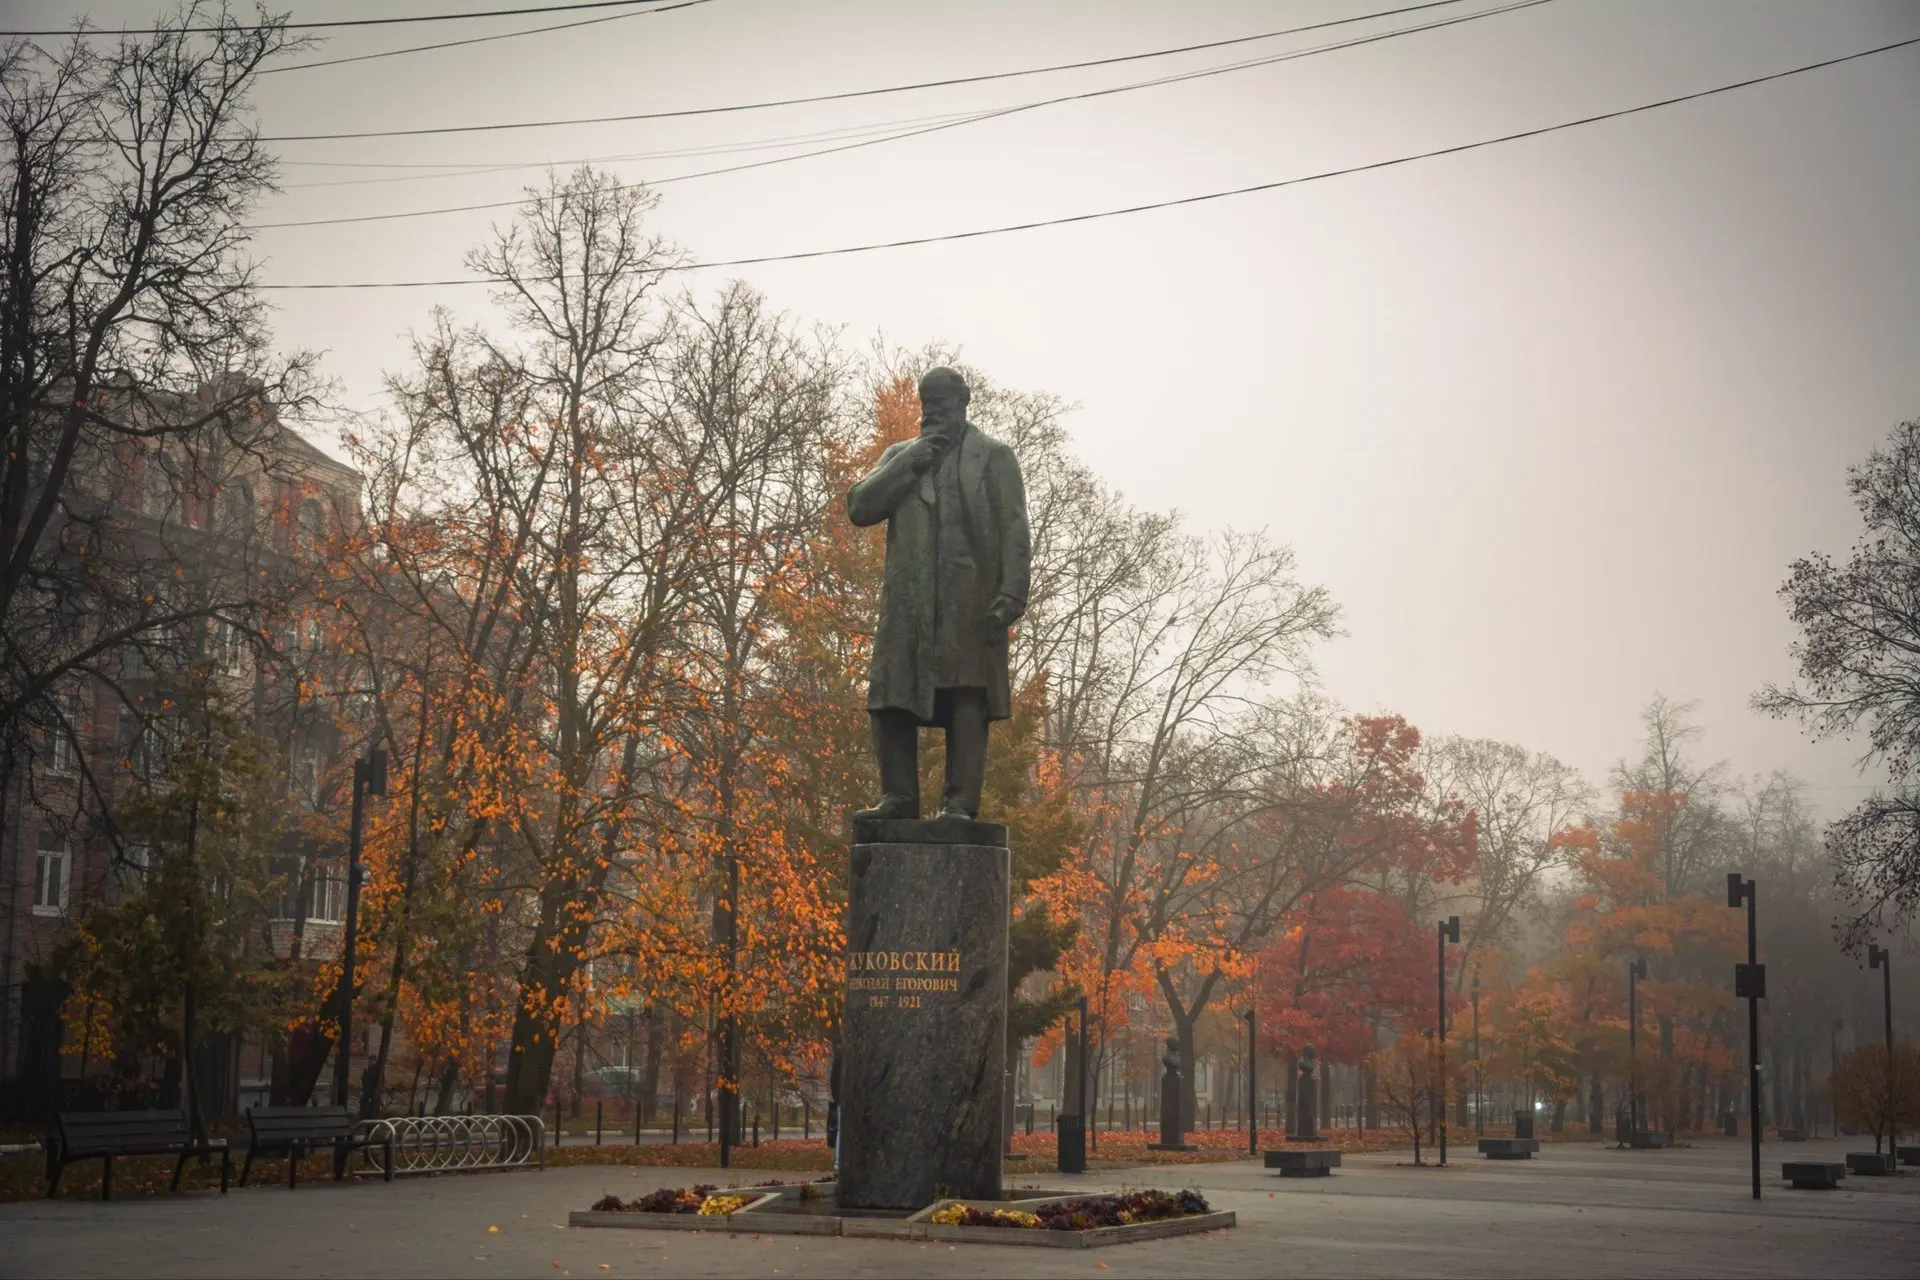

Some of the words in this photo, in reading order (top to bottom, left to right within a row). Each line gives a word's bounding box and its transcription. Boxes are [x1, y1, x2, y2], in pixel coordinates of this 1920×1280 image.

[849, 947, 961, 972] ЖУКОВСКИЙ
[895, 977, 958, 991] ЕГОРОВИЧ
[869, 995, 889, 1008] 1847
[898, 995, 921, 1008] 1921
